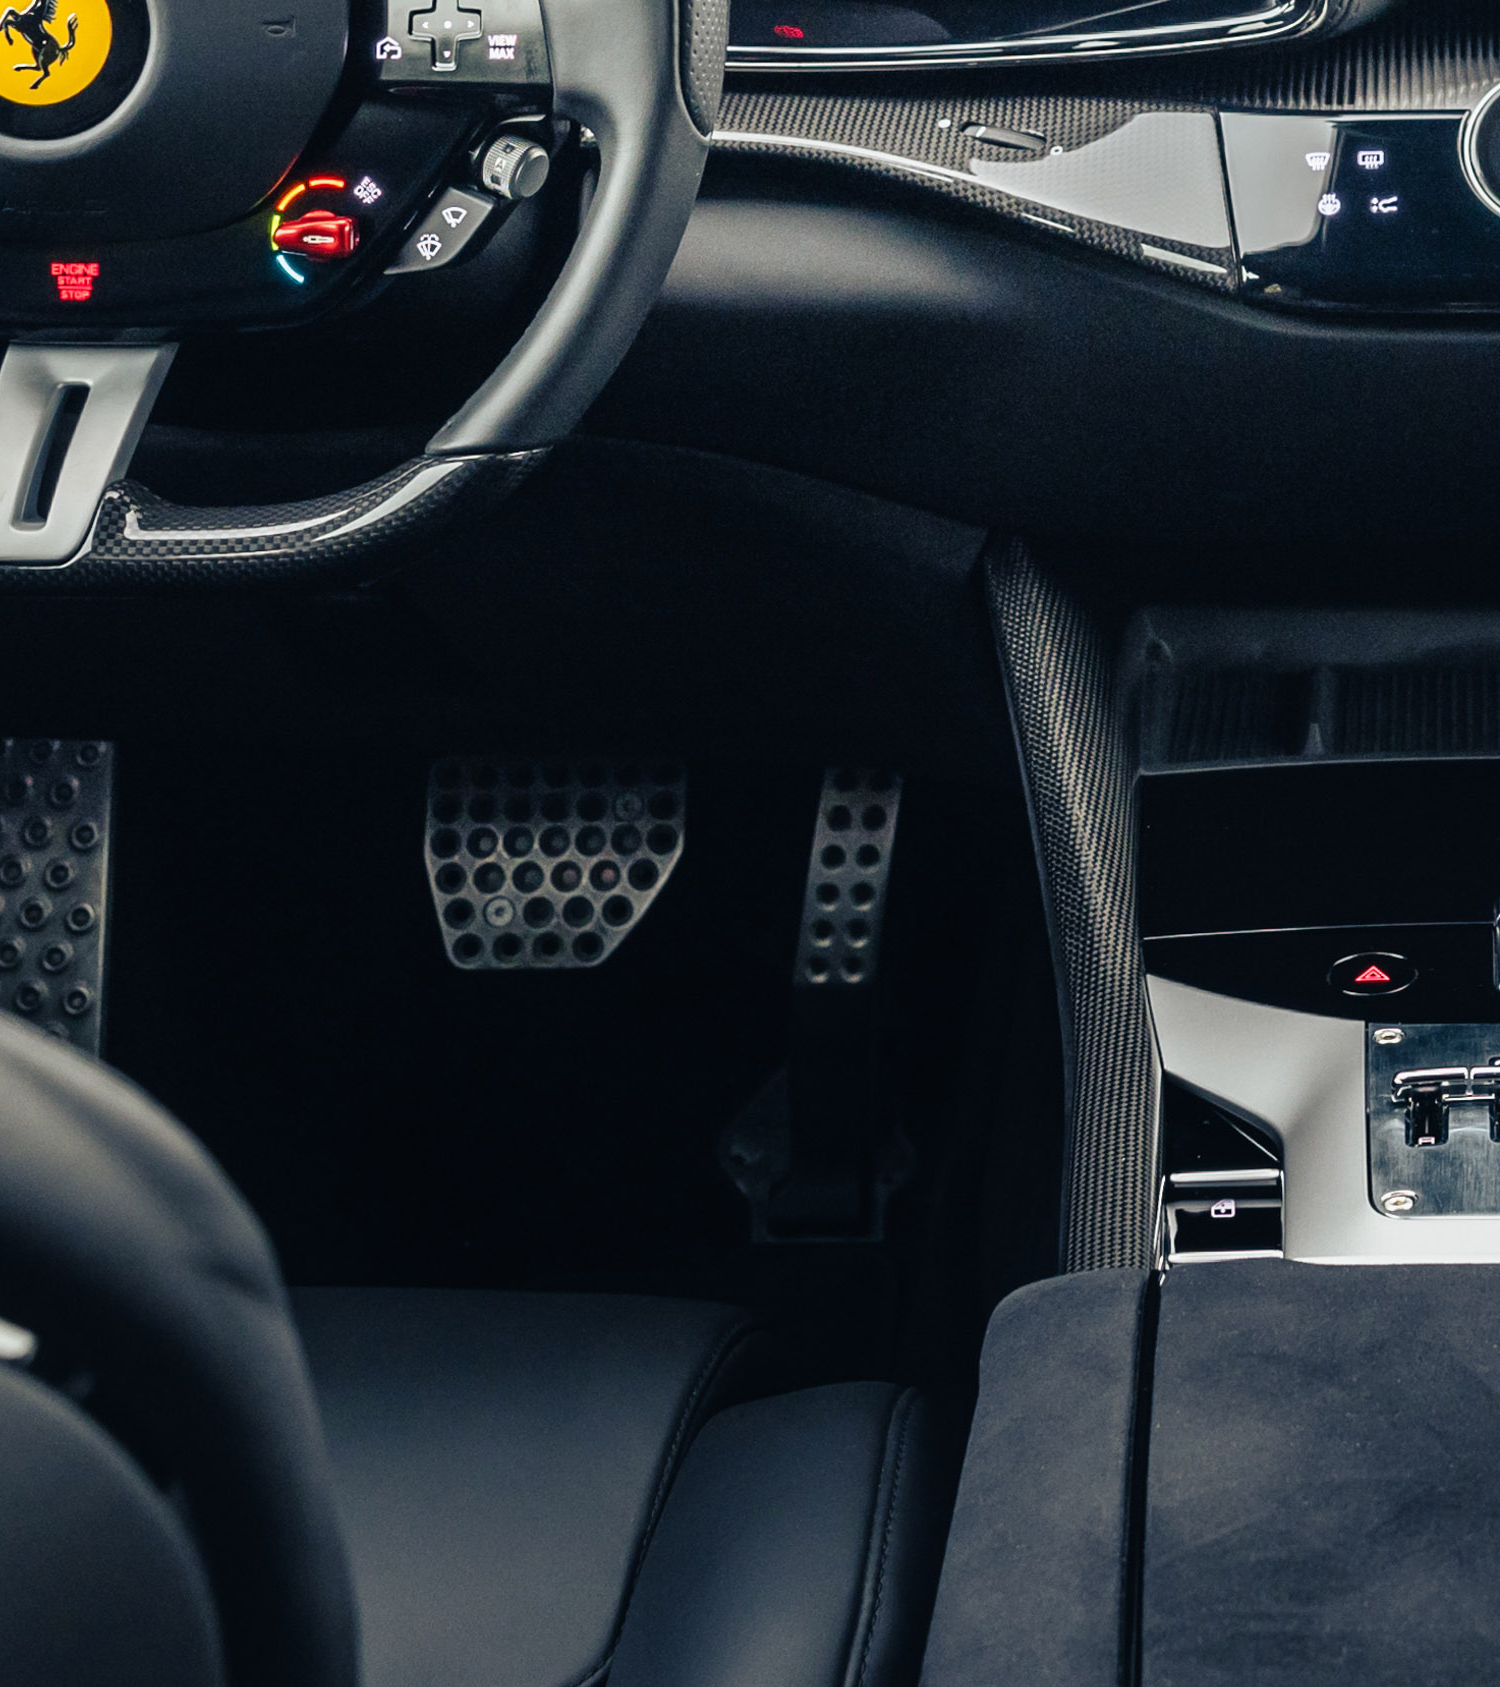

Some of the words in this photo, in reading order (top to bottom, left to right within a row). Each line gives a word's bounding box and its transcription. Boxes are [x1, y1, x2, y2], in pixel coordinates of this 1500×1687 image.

[488, 34, 517, 46] VIEW
[489, 47, 515, 60] MAX
[51, 262, 100, 277] ENGINE
[57, 276, 93, 286] START
[60, 289, 92, 301] STOP
